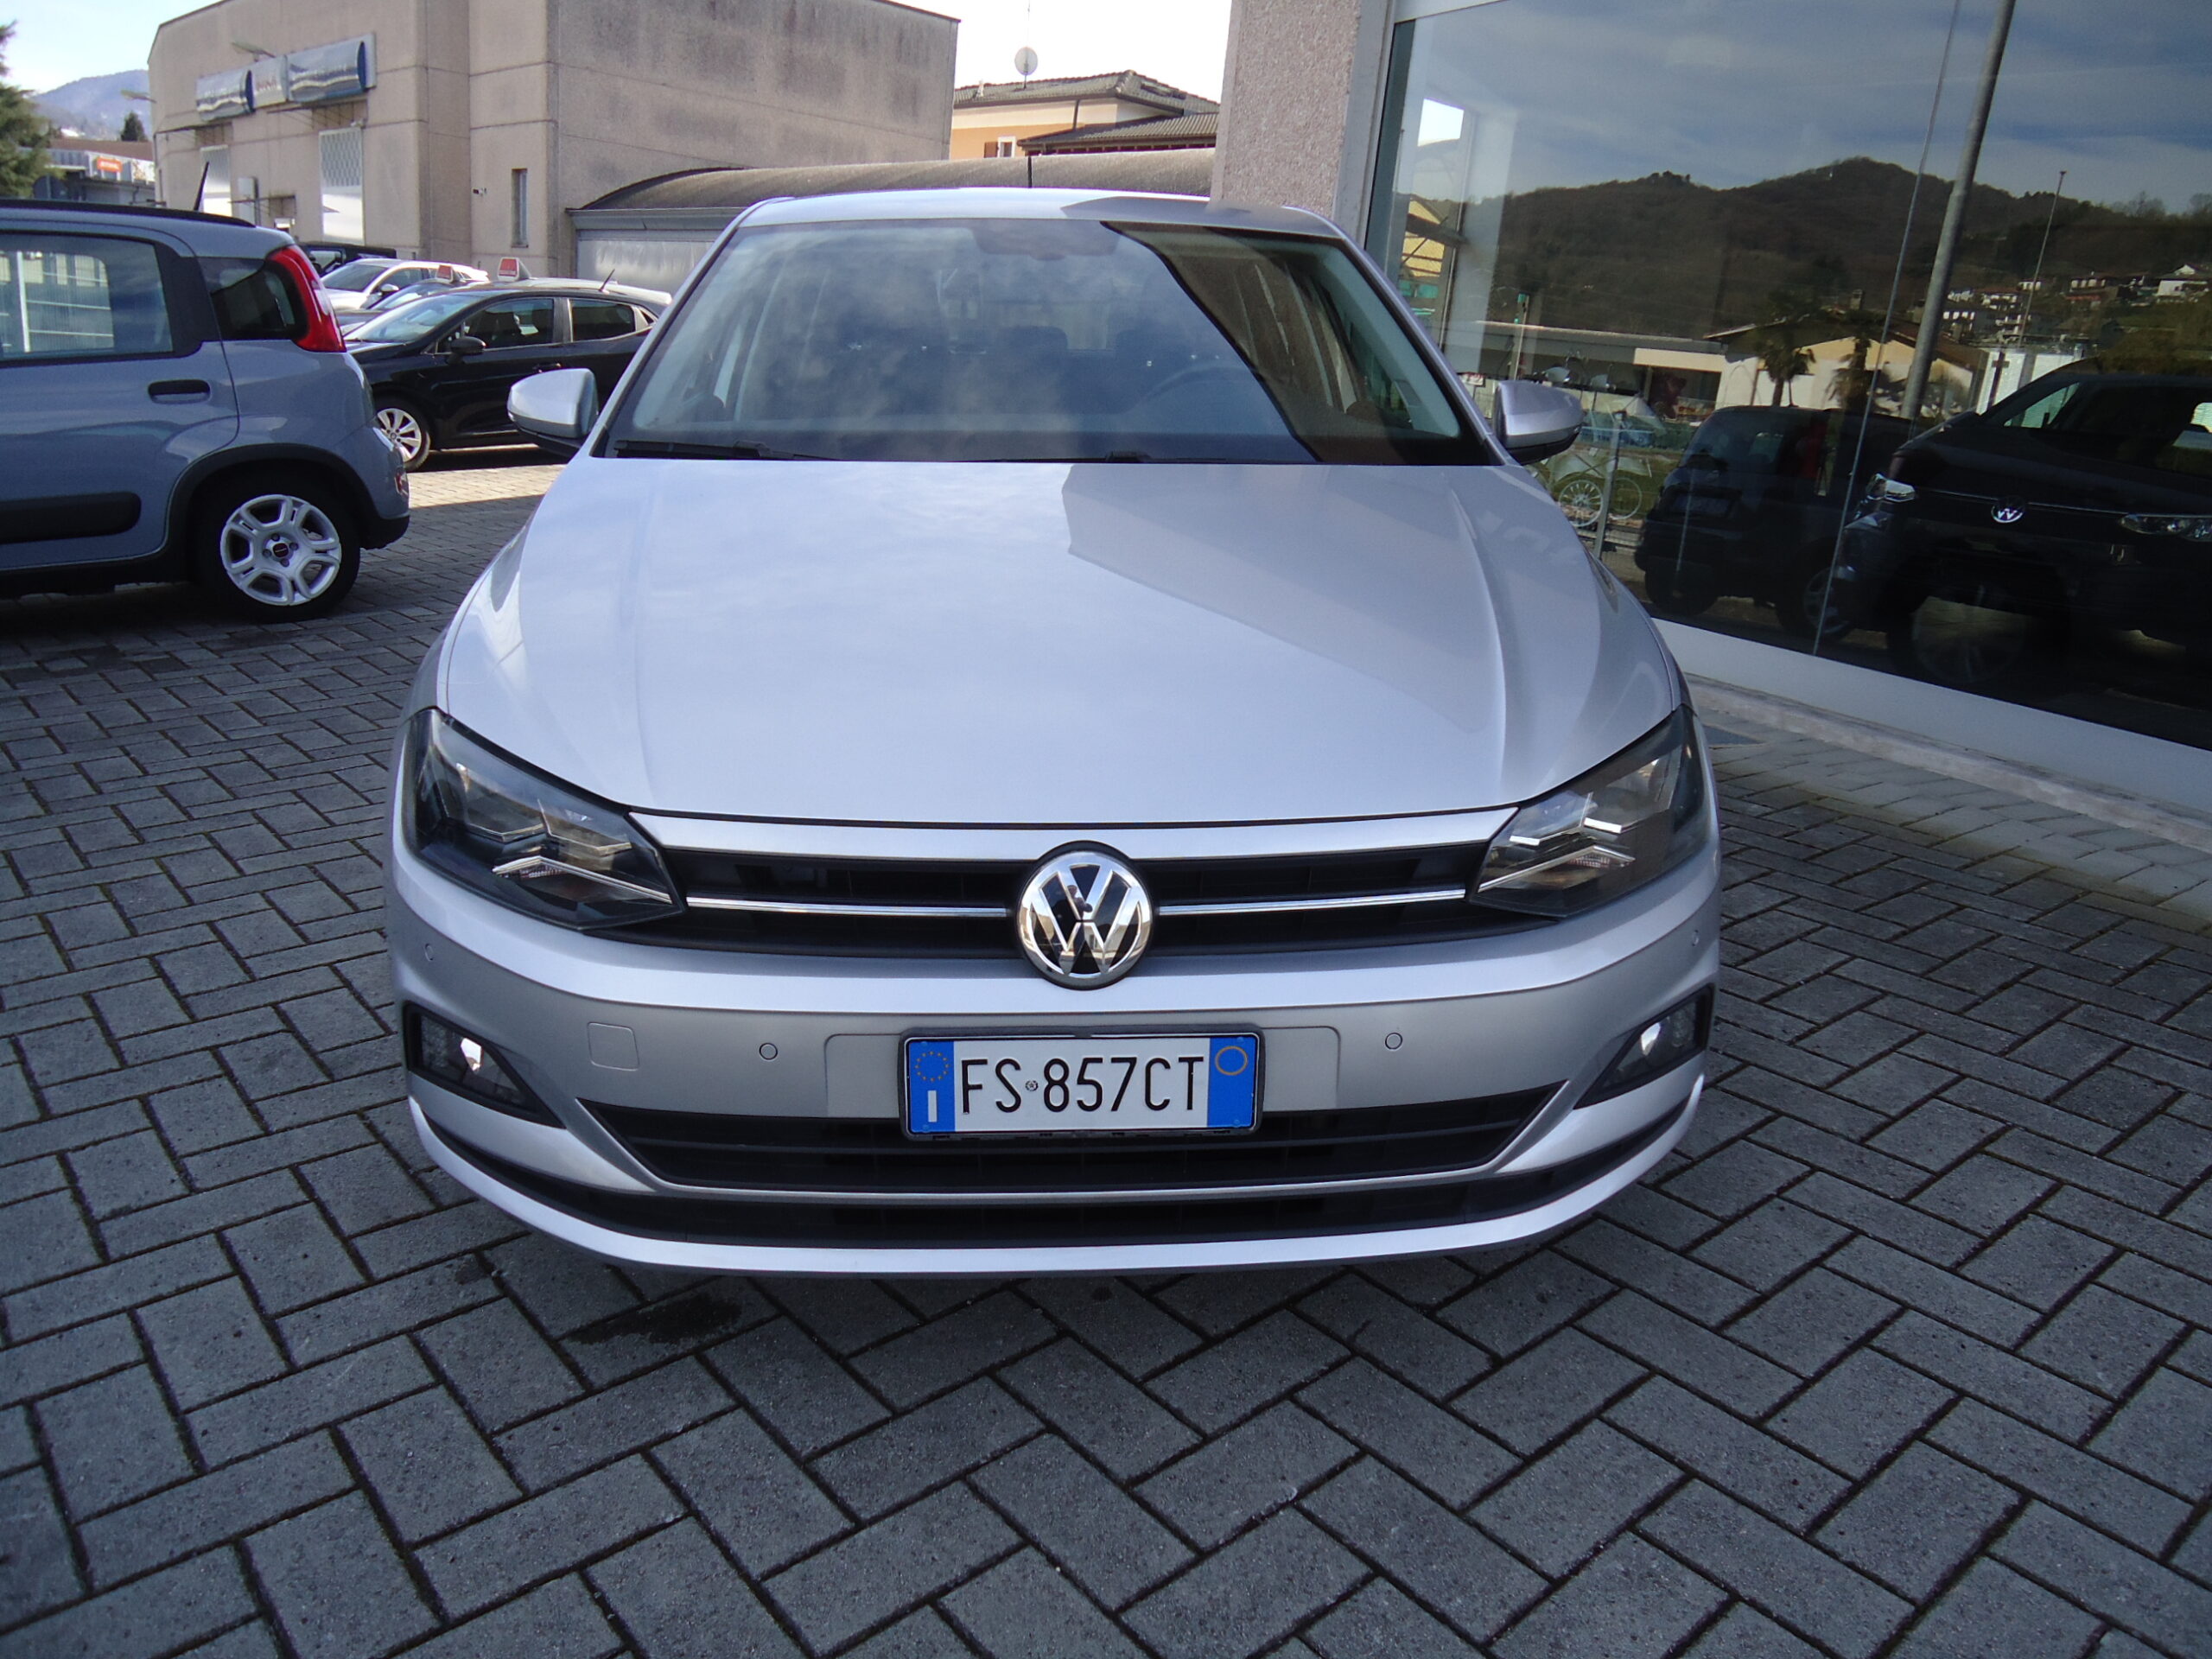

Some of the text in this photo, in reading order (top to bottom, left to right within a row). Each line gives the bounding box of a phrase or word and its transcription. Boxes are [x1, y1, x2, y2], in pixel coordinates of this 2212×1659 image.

[926, 1090, 938, 1122] I
[961, 1056, 1205, 1114] FS 857CT
